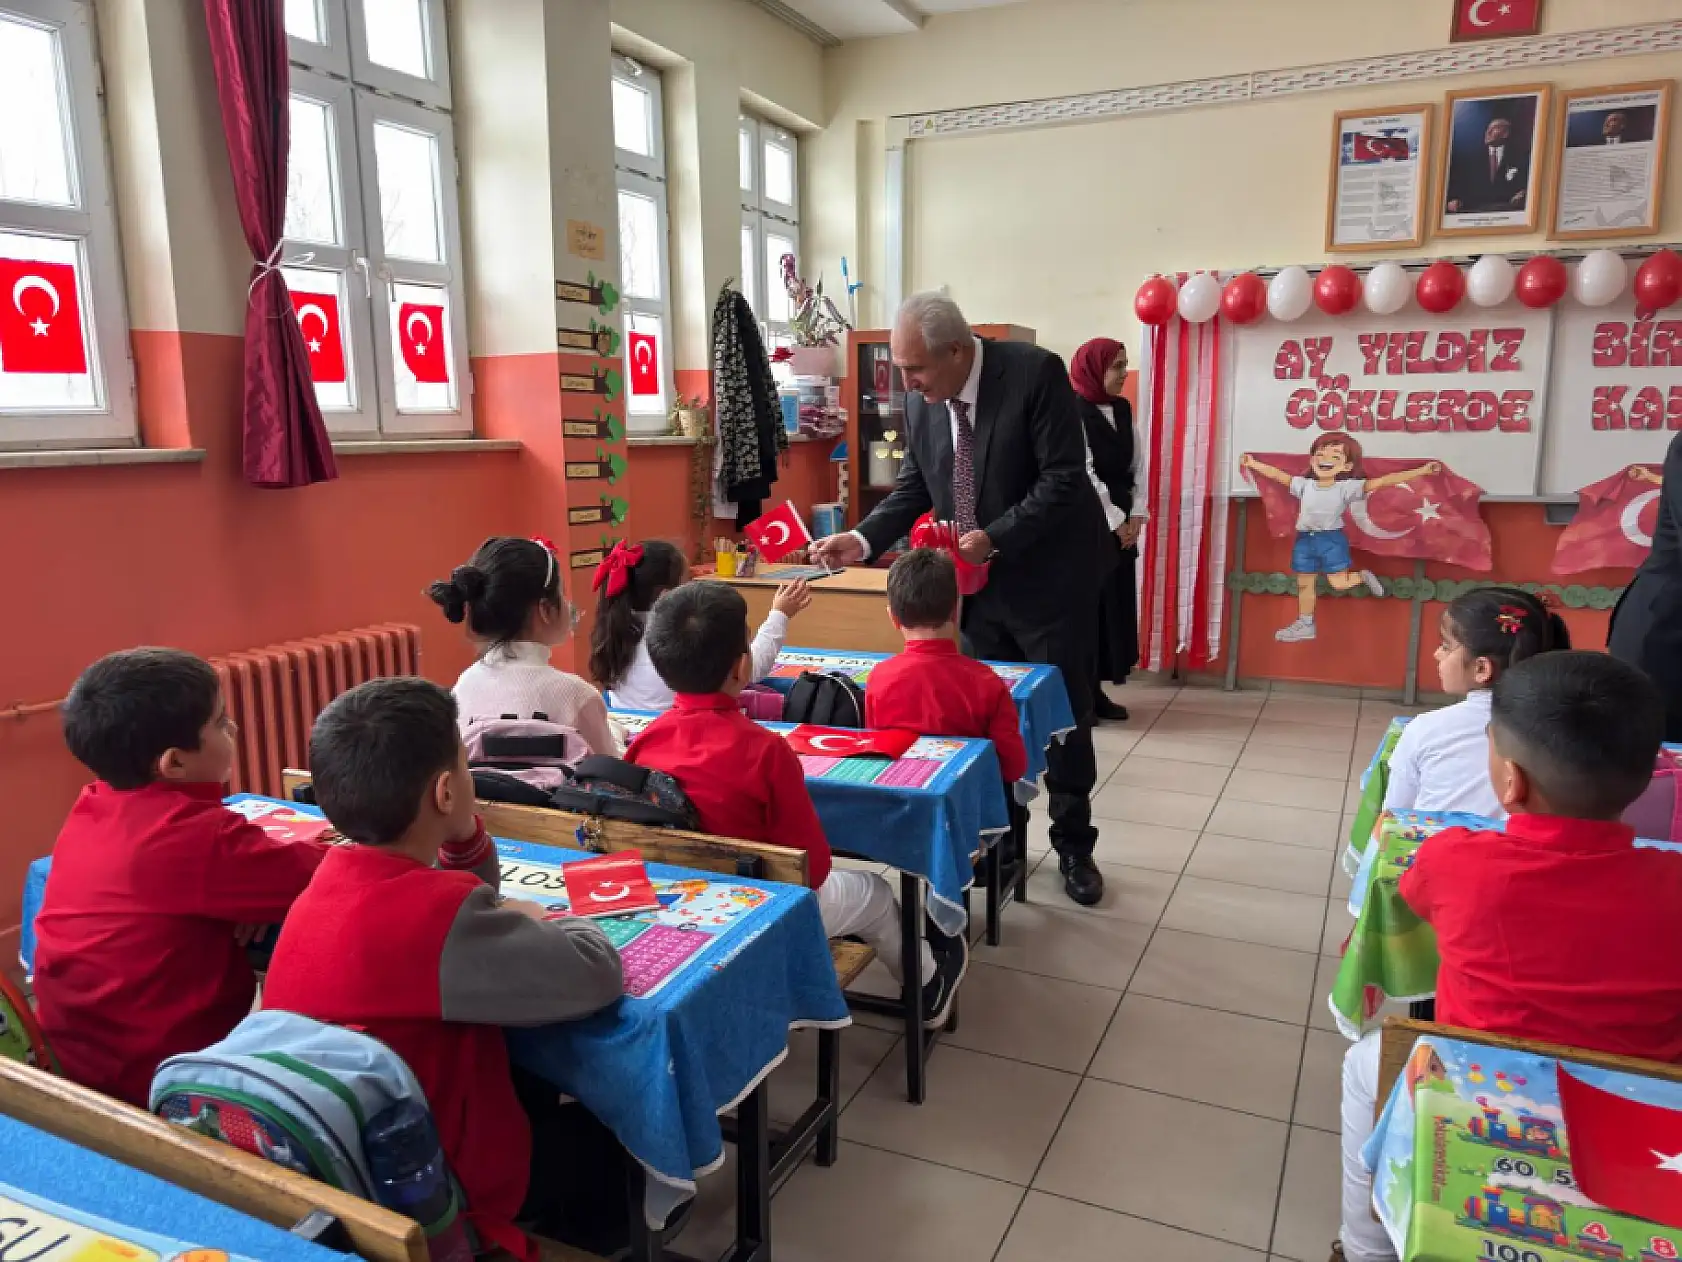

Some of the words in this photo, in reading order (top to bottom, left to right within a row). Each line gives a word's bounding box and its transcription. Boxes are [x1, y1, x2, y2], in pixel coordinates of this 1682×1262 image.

[1274, 336, 1333, 379] AY
[1358, 328, 1526, 375] YILDIZ
[1285, 373, 1534, 433] GÖKLERDE
[1496, 1156, 1534, 1177] 60
